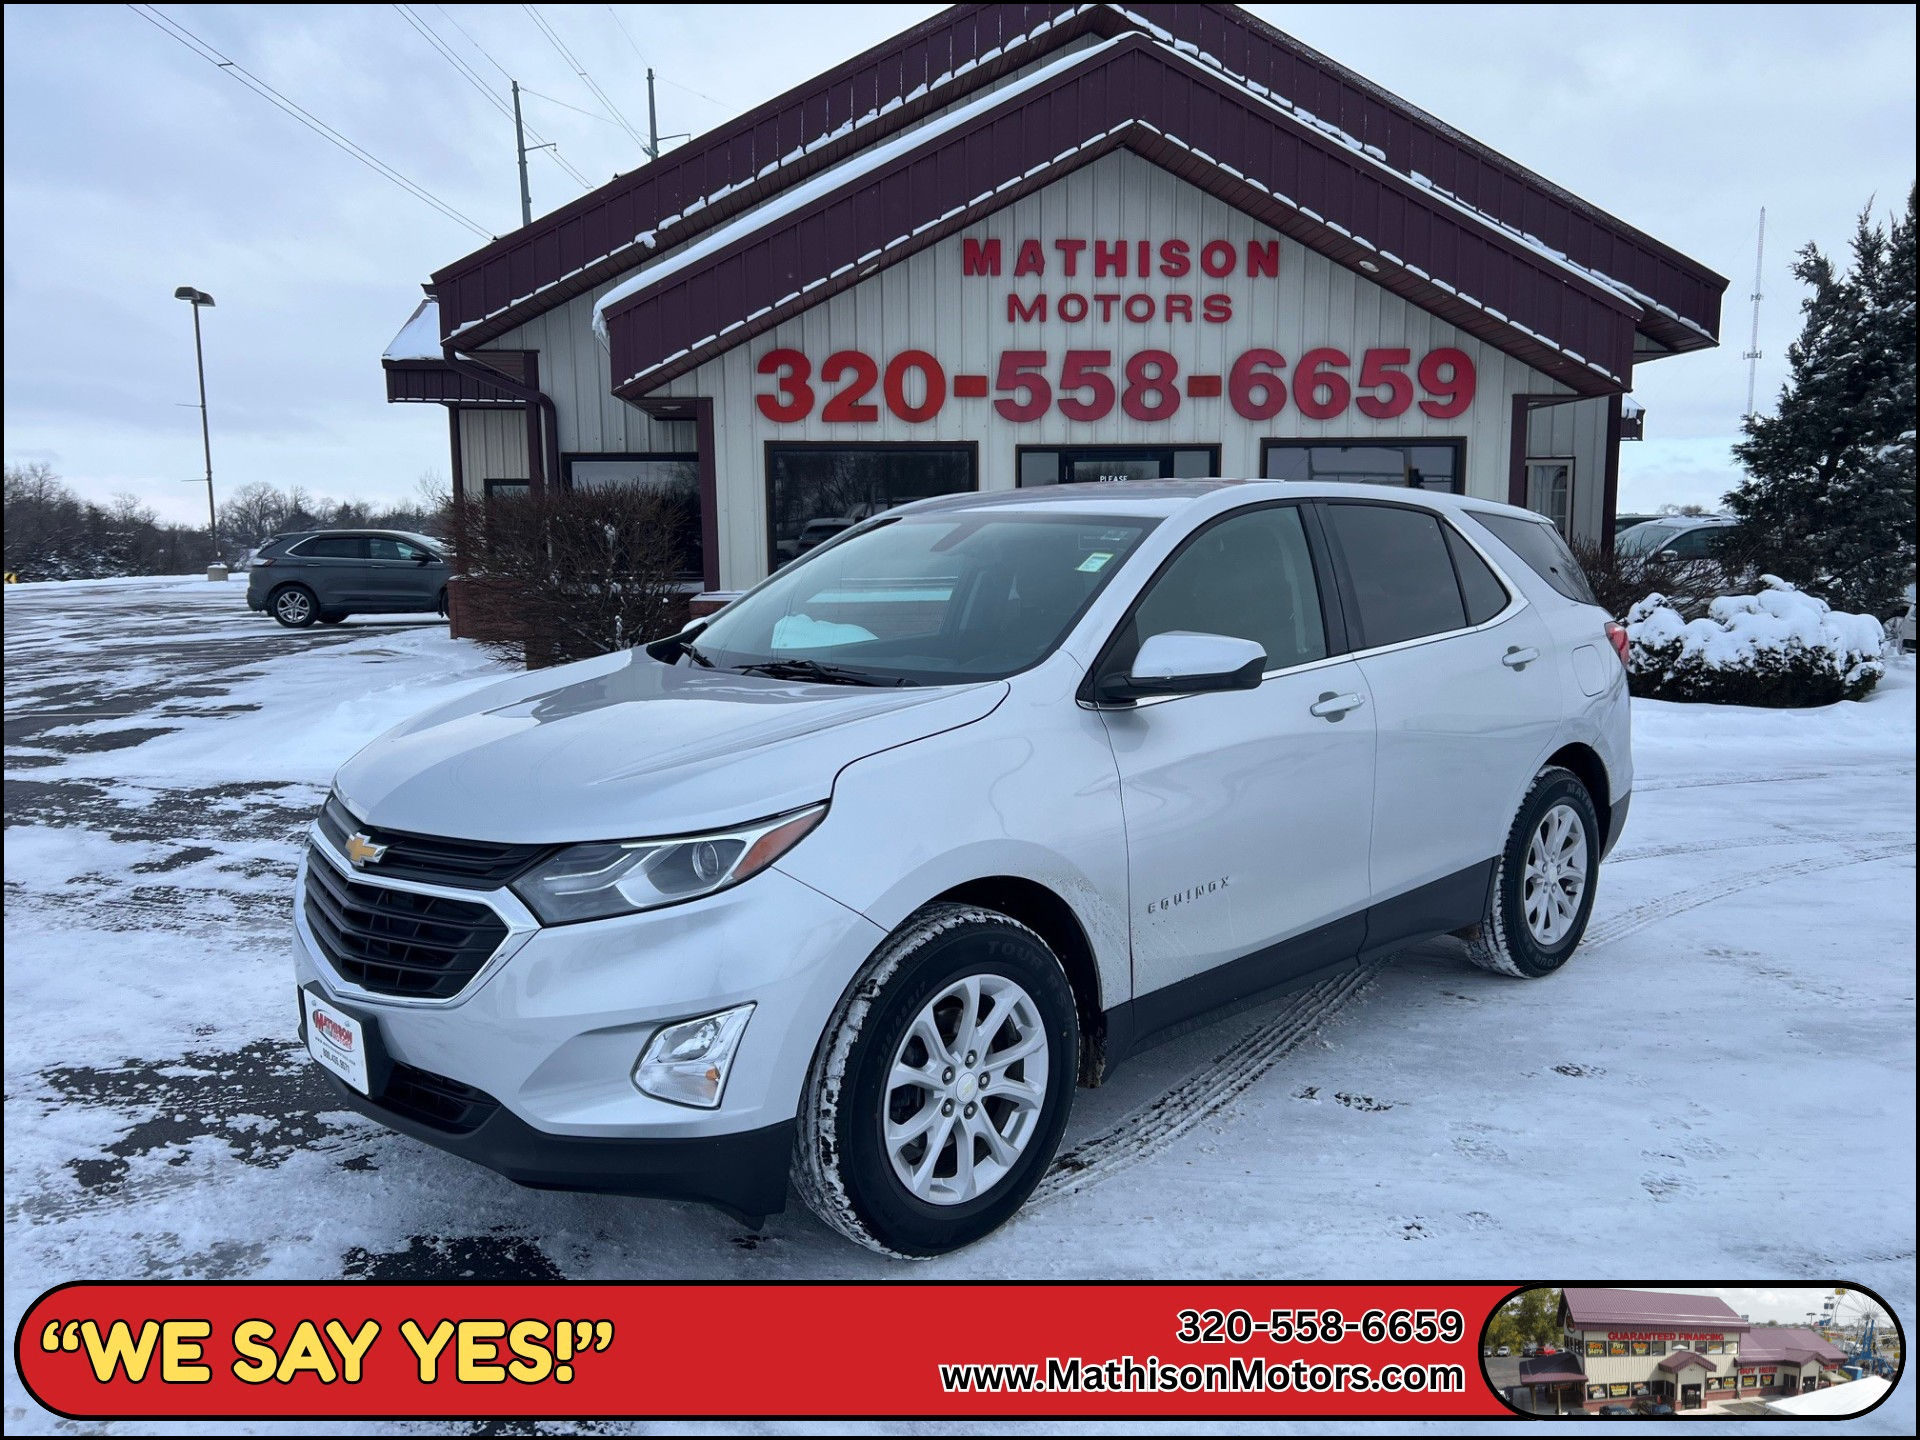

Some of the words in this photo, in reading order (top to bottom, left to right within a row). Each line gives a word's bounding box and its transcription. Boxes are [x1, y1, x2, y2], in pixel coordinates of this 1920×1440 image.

[963, 238, 1280, 277] MATHISON
[1007, 293, 1233, 323] MOTORS
[756, 347, 1477, 423] 320-558-6659
[1147, 876, 1229, 914] EQUINOX
[987, 940, 1044, 971] TOUR
[1608, 1332, 1677, 1341] GUARANTEED
[1679, 1332, 1724, 1341] FINANCING
